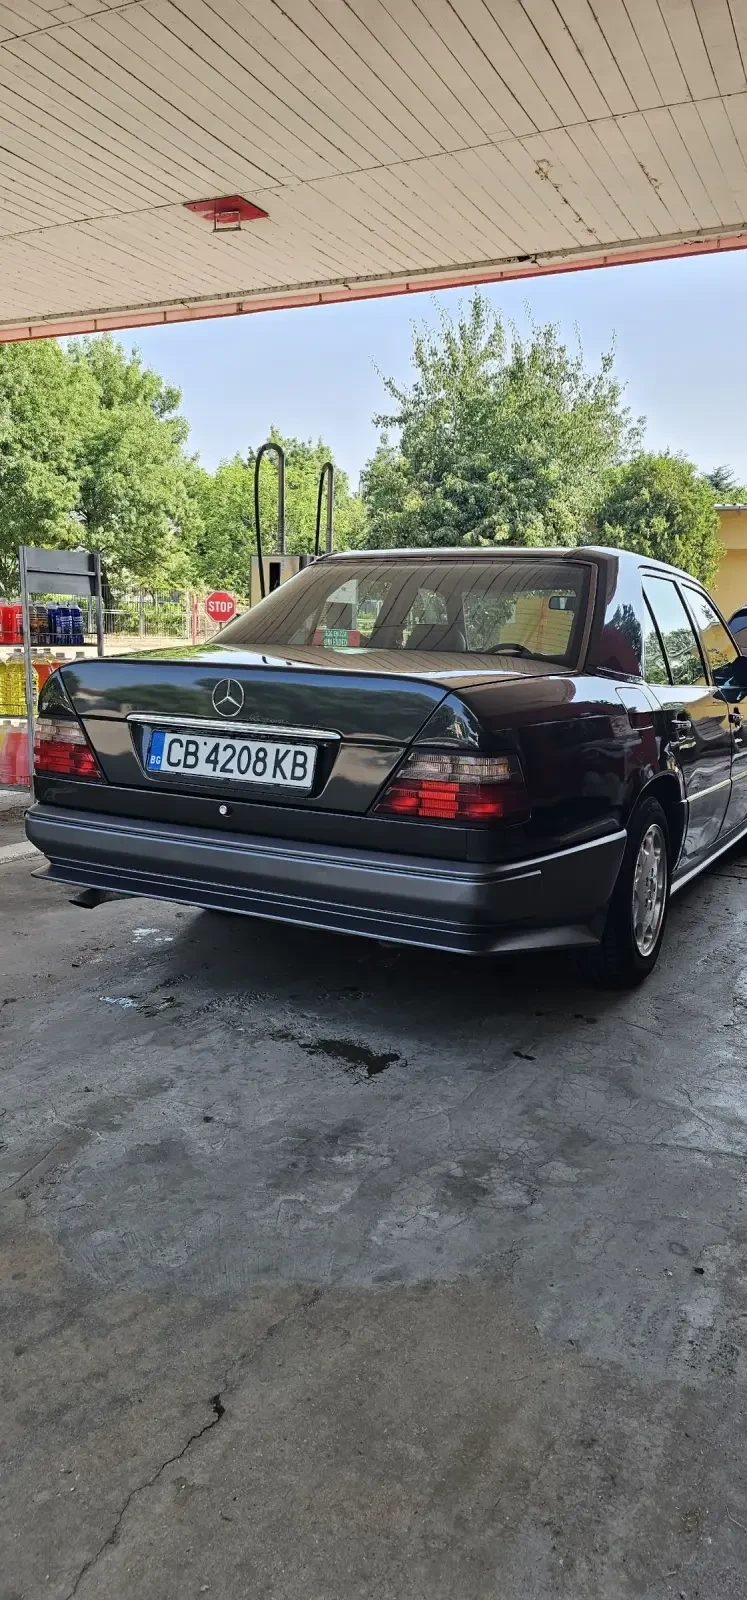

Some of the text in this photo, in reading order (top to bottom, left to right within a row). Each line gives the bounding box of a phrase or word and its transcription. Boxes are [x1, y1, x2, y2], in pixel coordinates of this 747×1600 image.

[208, 600, 233, 613] STOP
[150, 755, 161, 765] BG
[166, 737, 308, 782] CB 4208 KB
